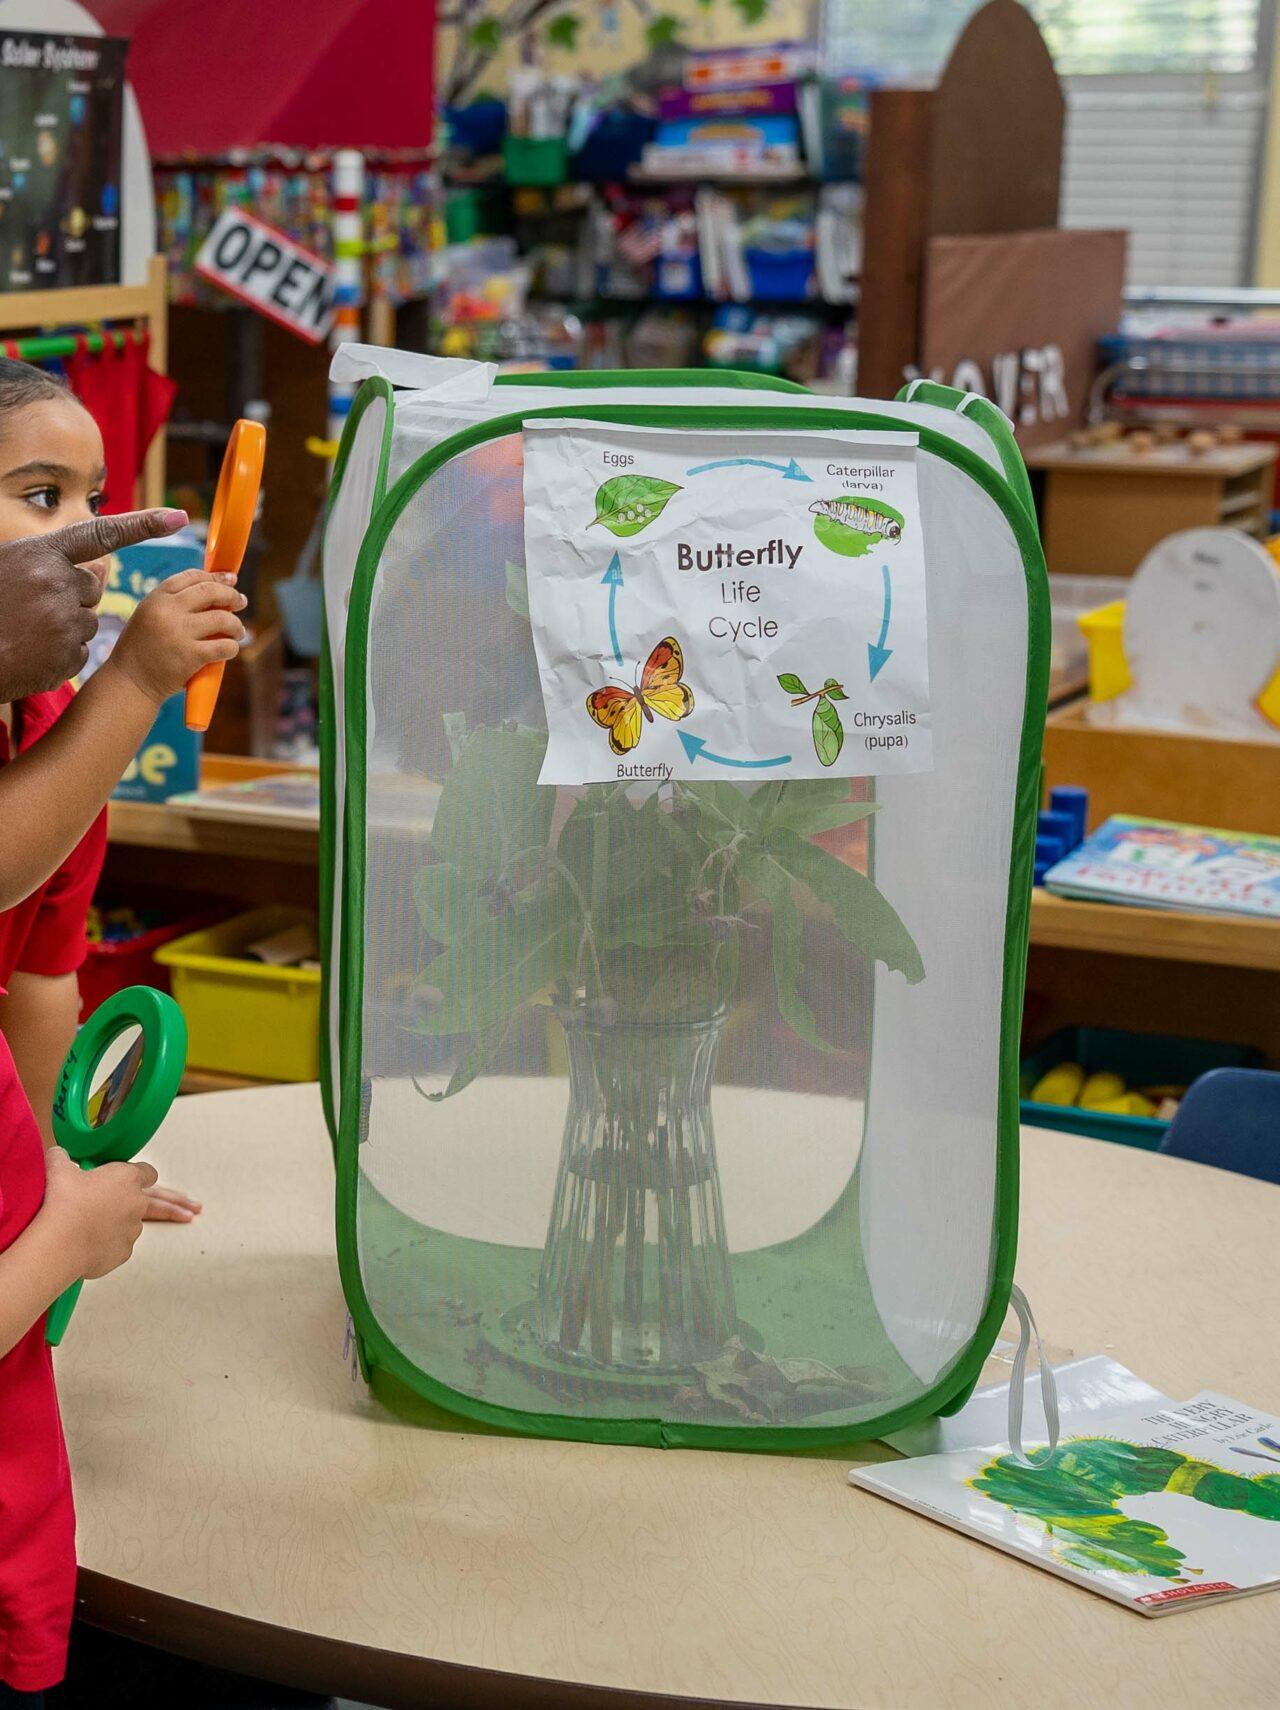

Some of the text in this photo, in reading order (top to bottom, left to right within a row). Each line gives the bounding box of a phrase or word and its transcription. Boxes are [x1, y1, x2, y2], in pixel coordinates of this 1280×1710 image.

[215, 225, 332, 326] OPEN
[903, 347, 1069, 426] OVER
[603, 450, 635, 468] Eggs
[826, 463, 896, 479] Caterpillar
[841, 480, 884, 491] (larva)
[677, 539, 804, 571] Butterfly
[721, 580, 761, 604] Life
[708, 616, 779, 642] Cycle
[853, 710, 917, 729] Chrysalis
[864, 735, 909, 751] (pupa)
[616, 763, 674, 781] Butterfly
[1172, 1399, 1218, 1418] VERY
